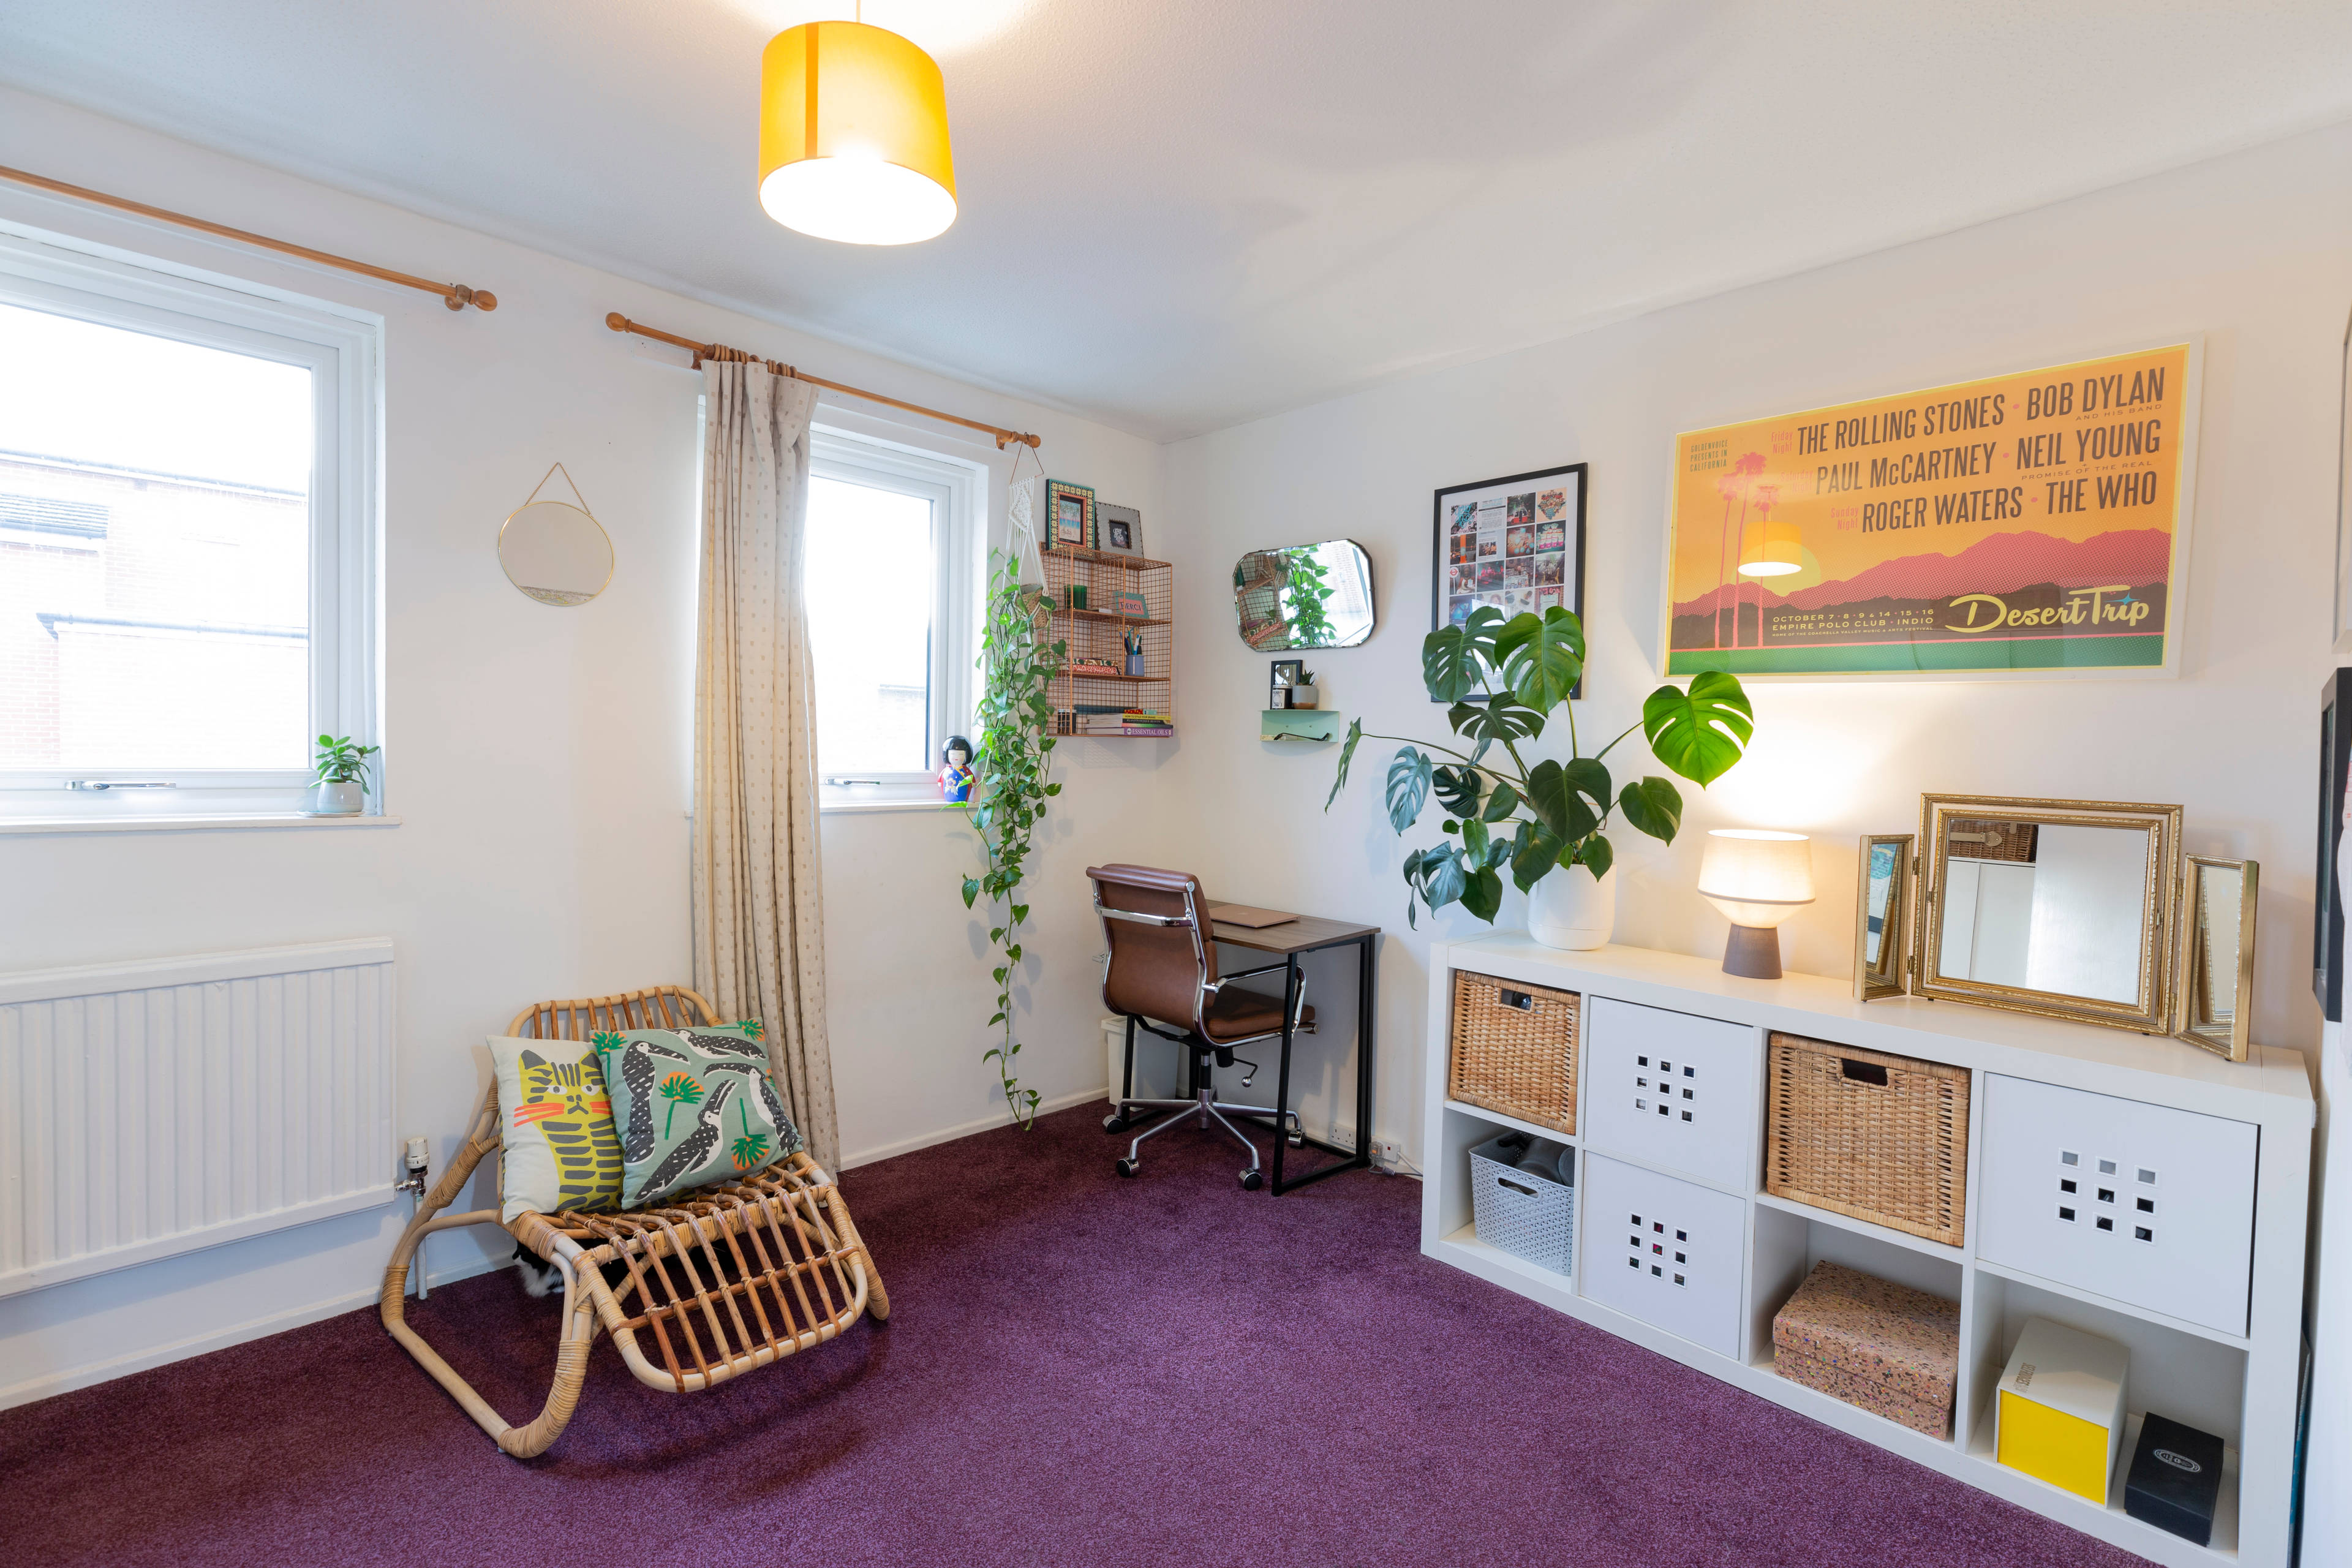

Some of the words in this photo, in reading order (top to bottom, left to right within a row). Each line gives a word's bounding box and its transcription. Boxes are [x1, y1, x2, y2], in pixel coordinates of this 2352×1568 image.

[1798, 423, 1830, 455] THE
[1834, 409, 1916, 450] ROLLING
[1923, 394, 2005, 436] STONES
[2027, 382, 2073, 421] BOB
[2082, 366, 2165, 413] DYLAN
[2128, 404, 2162, 414] BAND
[1771, 431, 1793, 442] Friday
[1691, 440, 1728, 453] GOLDENVOICE
[1773, 442, 1792, 454] Night
[1691, 451, 1719, 462] PRESENTS
[1816, 461, 1863, 495] PAUL
[1869, 442, 1997, 488] McCARTNEY
[2016, 432, 2066, 470] NEIL
[2076, 419, 2161, 462] YOUNG
[1690, 459, 1727, 472] CALIFORNIA
[1780, 469, 1814, 482] Saturday
[2021, 470, 2071, 480] PROMISE
[1862, 497, 1928, 533] ROGER
[1934, 486, 2023, 526] WATERS
[2046, 478, 2088, 514] THE
[2097, 470, 2157, 510] WHO
[1831, 505, 1859, 519] Sunday
[1838, 518, 1858, 530] Night
[1945, 594, 2090, 633] Desert
[2068, 584, 2149, 627] Trip
[1773, 614, 1825, 623] OCTOBER
[1897, 617, 1934, 625] INDIO
